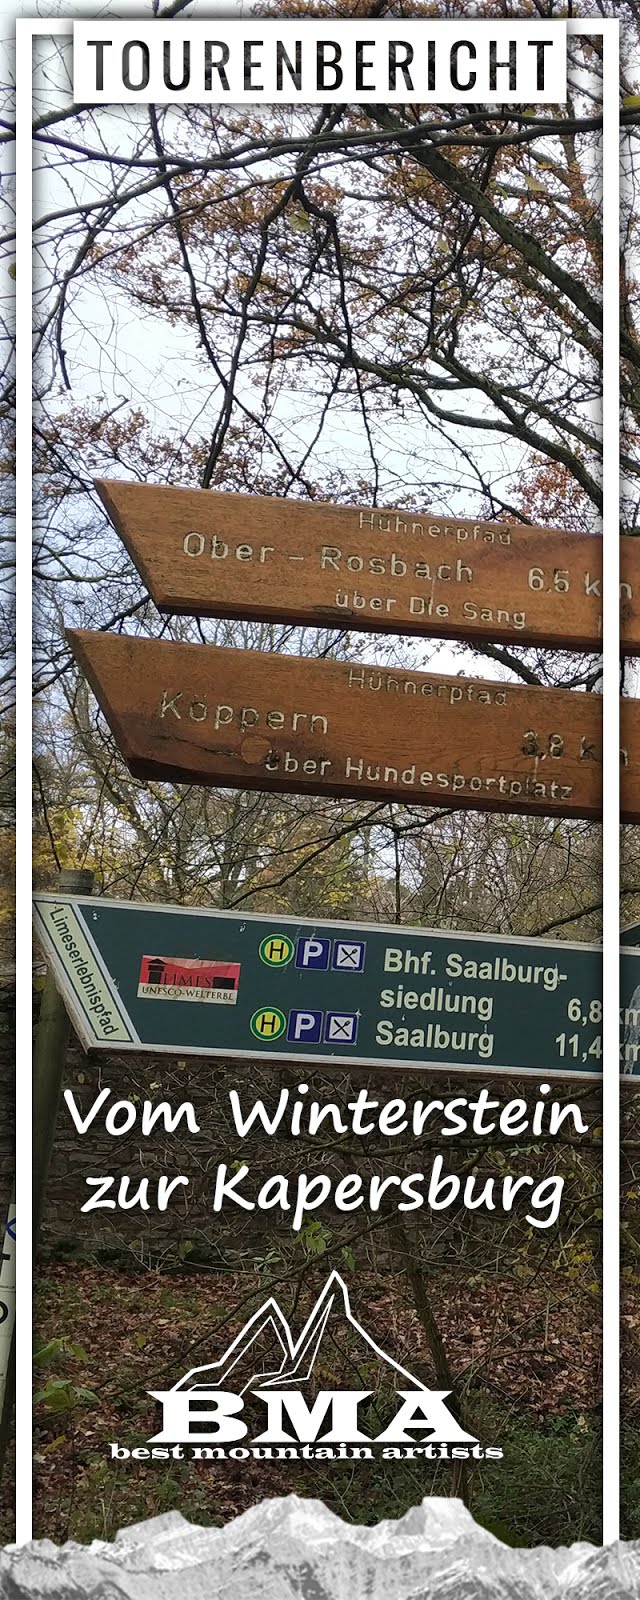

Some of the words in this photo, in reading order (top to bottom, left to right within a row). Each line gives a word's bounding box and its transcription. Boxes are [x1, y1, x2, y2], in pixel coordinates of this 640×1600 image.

[358, 511, 512, 546] Hühnerpfad
[183, 532, 275, 563] Ober
[320, 546, 473, 583] Rosbach
[528, 567, 570, 594] 6,5
[335, 588, 396, 612] über
[410, 596, 449, 618] Die
[463, 602, 526, 630] Sang
[348, 668, 507, 707] Hühnerpfad
[160, 691, 329, 734] Köppern
[522, 729, 565, 761] 3,8
[264, 750, 331, 775] über
[345, 757, 574, 801] Hundesportplatz
[303, 941, 323, 965] P
[384, 948, 437, 976] Bhf.
[445, 953, 568, 991] Saalburg-
[49, 908, 119, 1036] Limeserlebnispfad
[142, 986, 234, 1001] UNESCO-WELTERBE
[379, 985, 493, 1021] siedlung
[295, 1014, 315, 1039] P
[568, 998, 603, 1026] 6,8
[375, 1020, 494, 1058] Saalburg
[555, 1033, 603, 1062] 11,4
